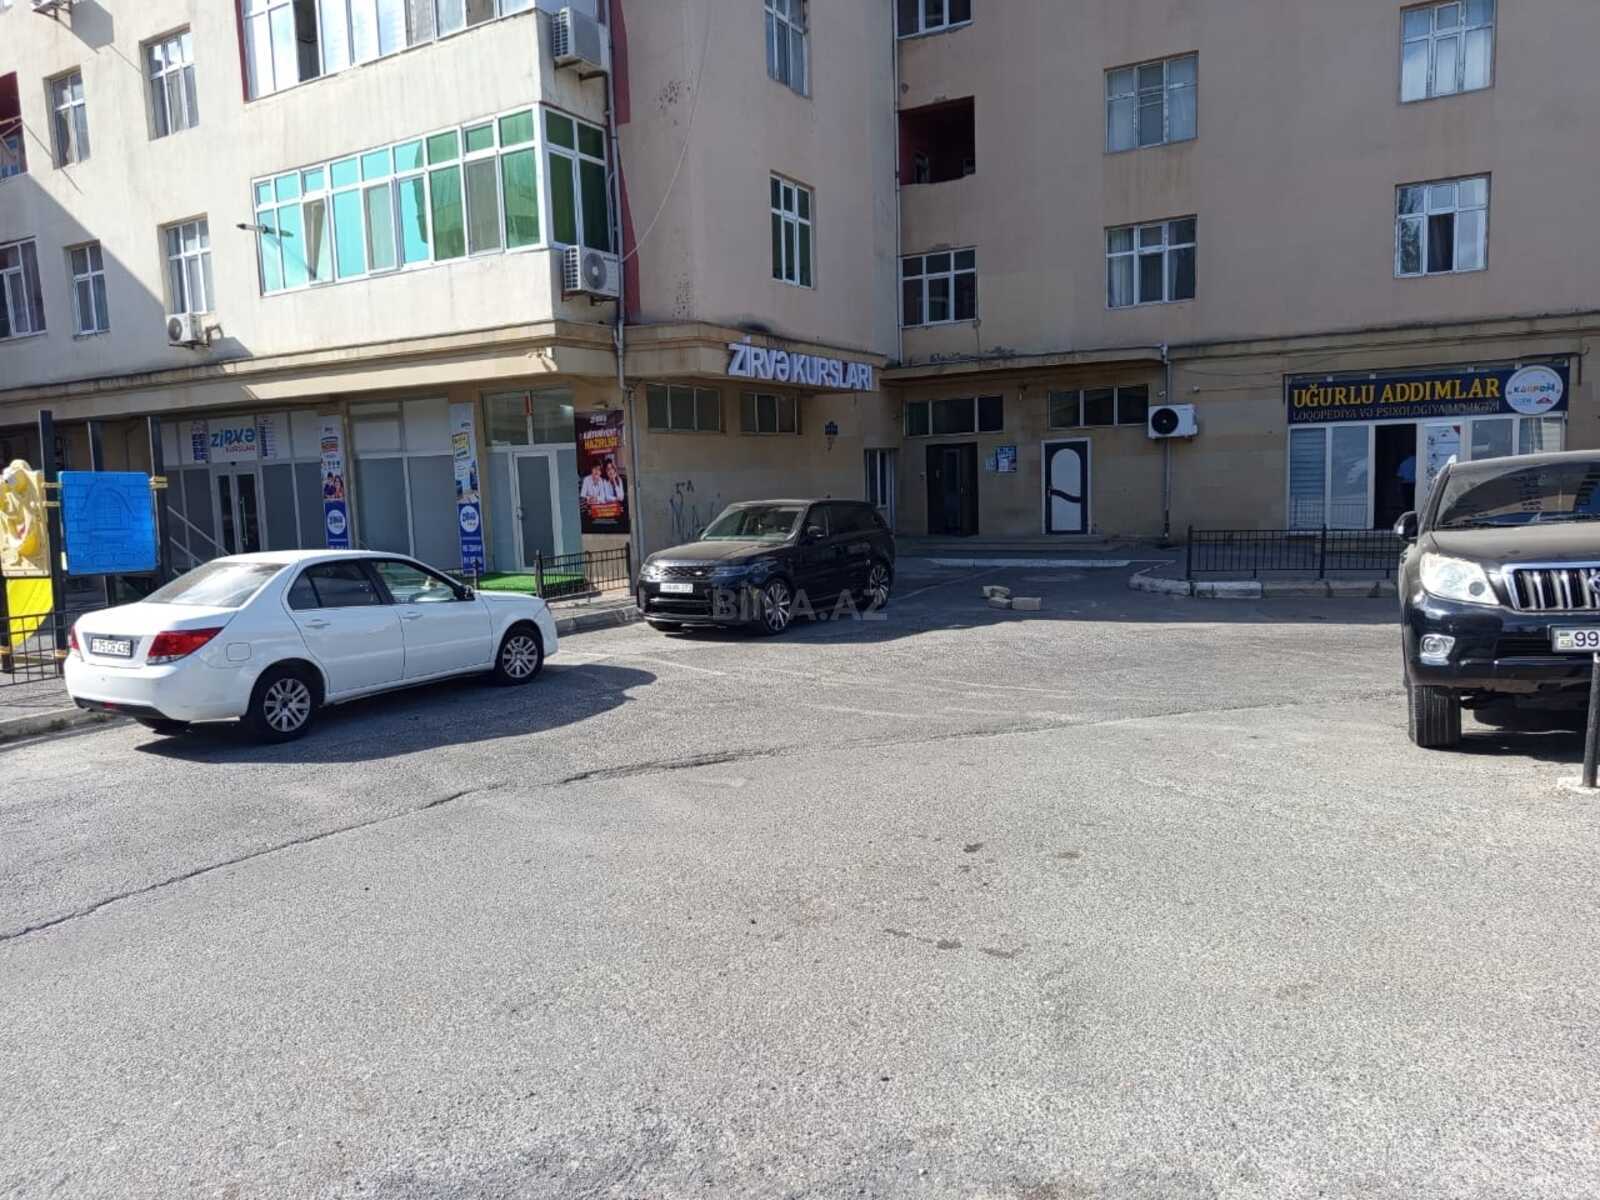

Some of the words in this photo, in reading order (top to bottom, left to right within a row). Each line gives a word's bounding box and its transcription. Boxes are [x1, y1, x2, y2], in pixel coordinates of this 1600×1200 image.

[728, 335, 790, 381] ZİRVƏ
[790, 351, 873, 391] KURSLARI
[1293, 383, 1376, 408] UĞURLU
[1379, 377, 1500, 403] ADDIMLAR
[1574, 631, 1600, 648] 99
